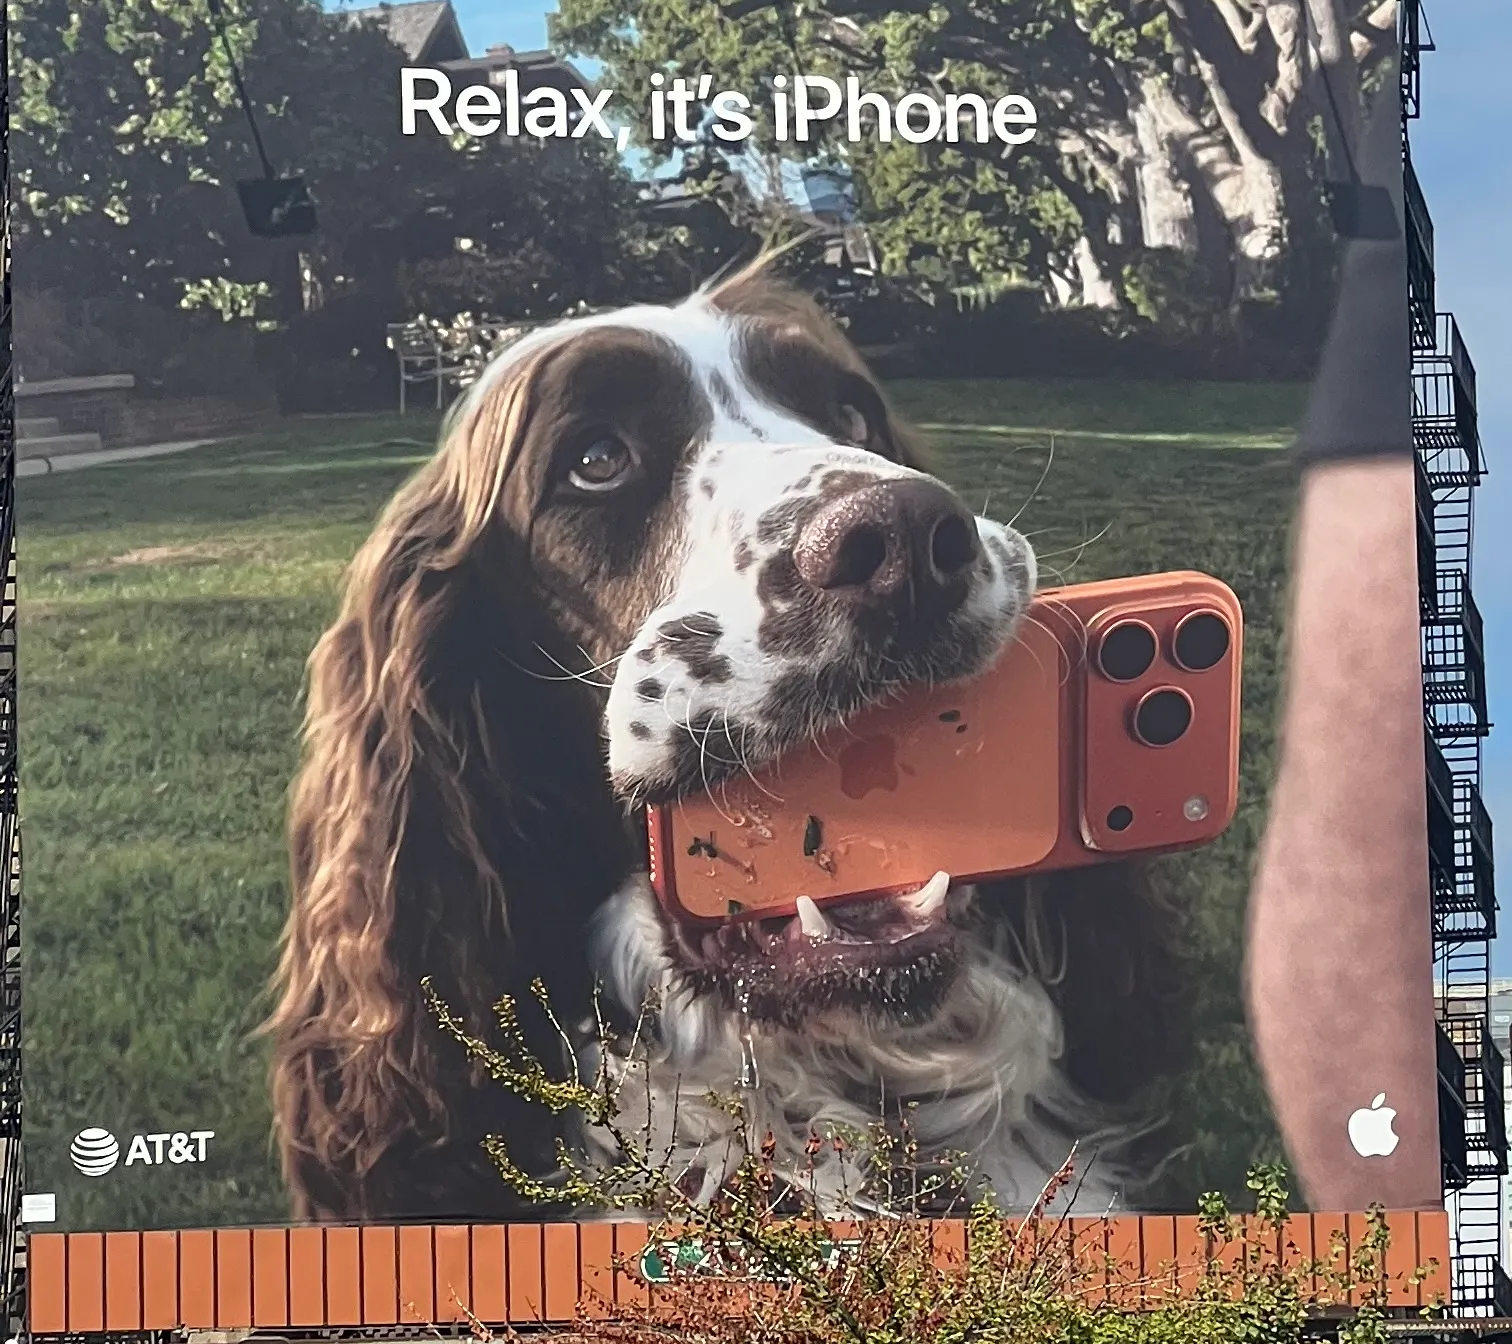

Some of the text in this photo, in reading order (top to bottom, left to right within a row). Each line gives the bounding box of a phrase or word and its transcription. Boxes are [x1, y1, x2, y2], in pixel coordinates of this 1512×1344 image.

[400, 67, 1038, 150] Relax, it's iPhone
[124, 1130, 216, 1166] AT&T
